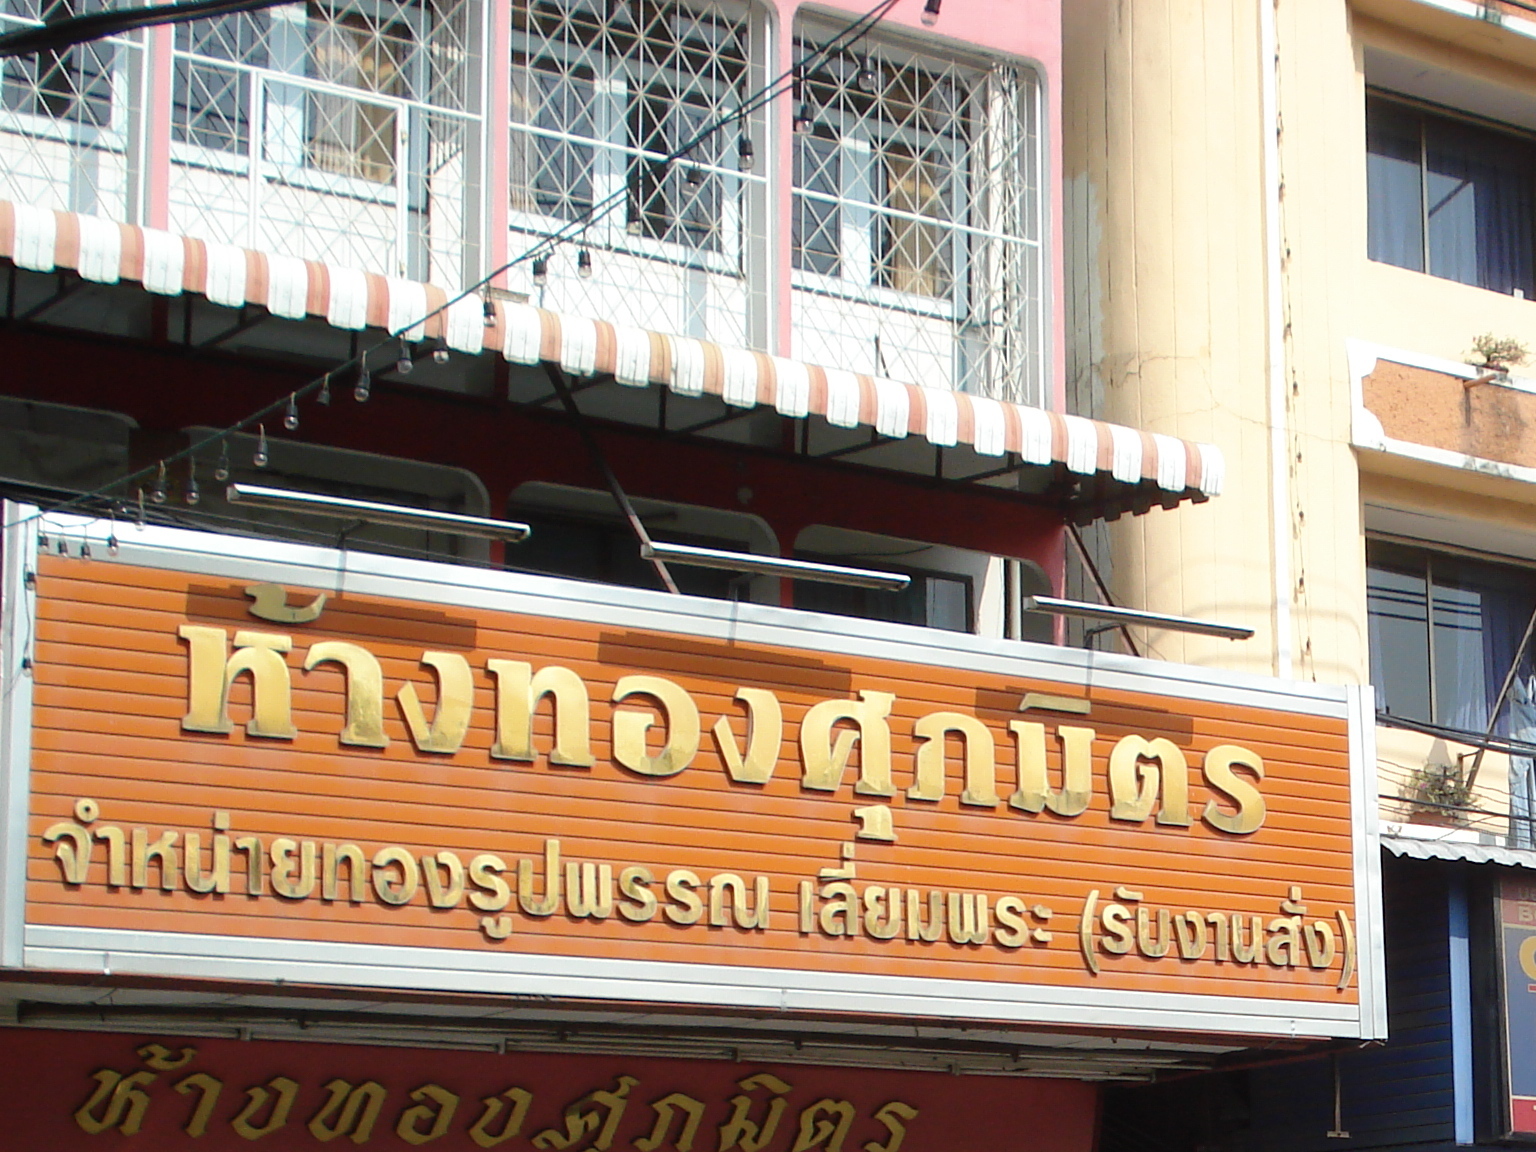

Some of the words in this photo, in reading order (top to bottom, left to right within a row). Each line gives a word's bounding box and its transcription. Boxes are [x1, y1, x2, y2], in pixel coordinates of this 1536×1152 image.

[42, 797, 770, 939] จำหน่ายทองรูปพรรณ
[799, 841, 1054, 949] เลี่ยมพระ
[1081, 885, 1356, 990] (รับงานสั่ง)
